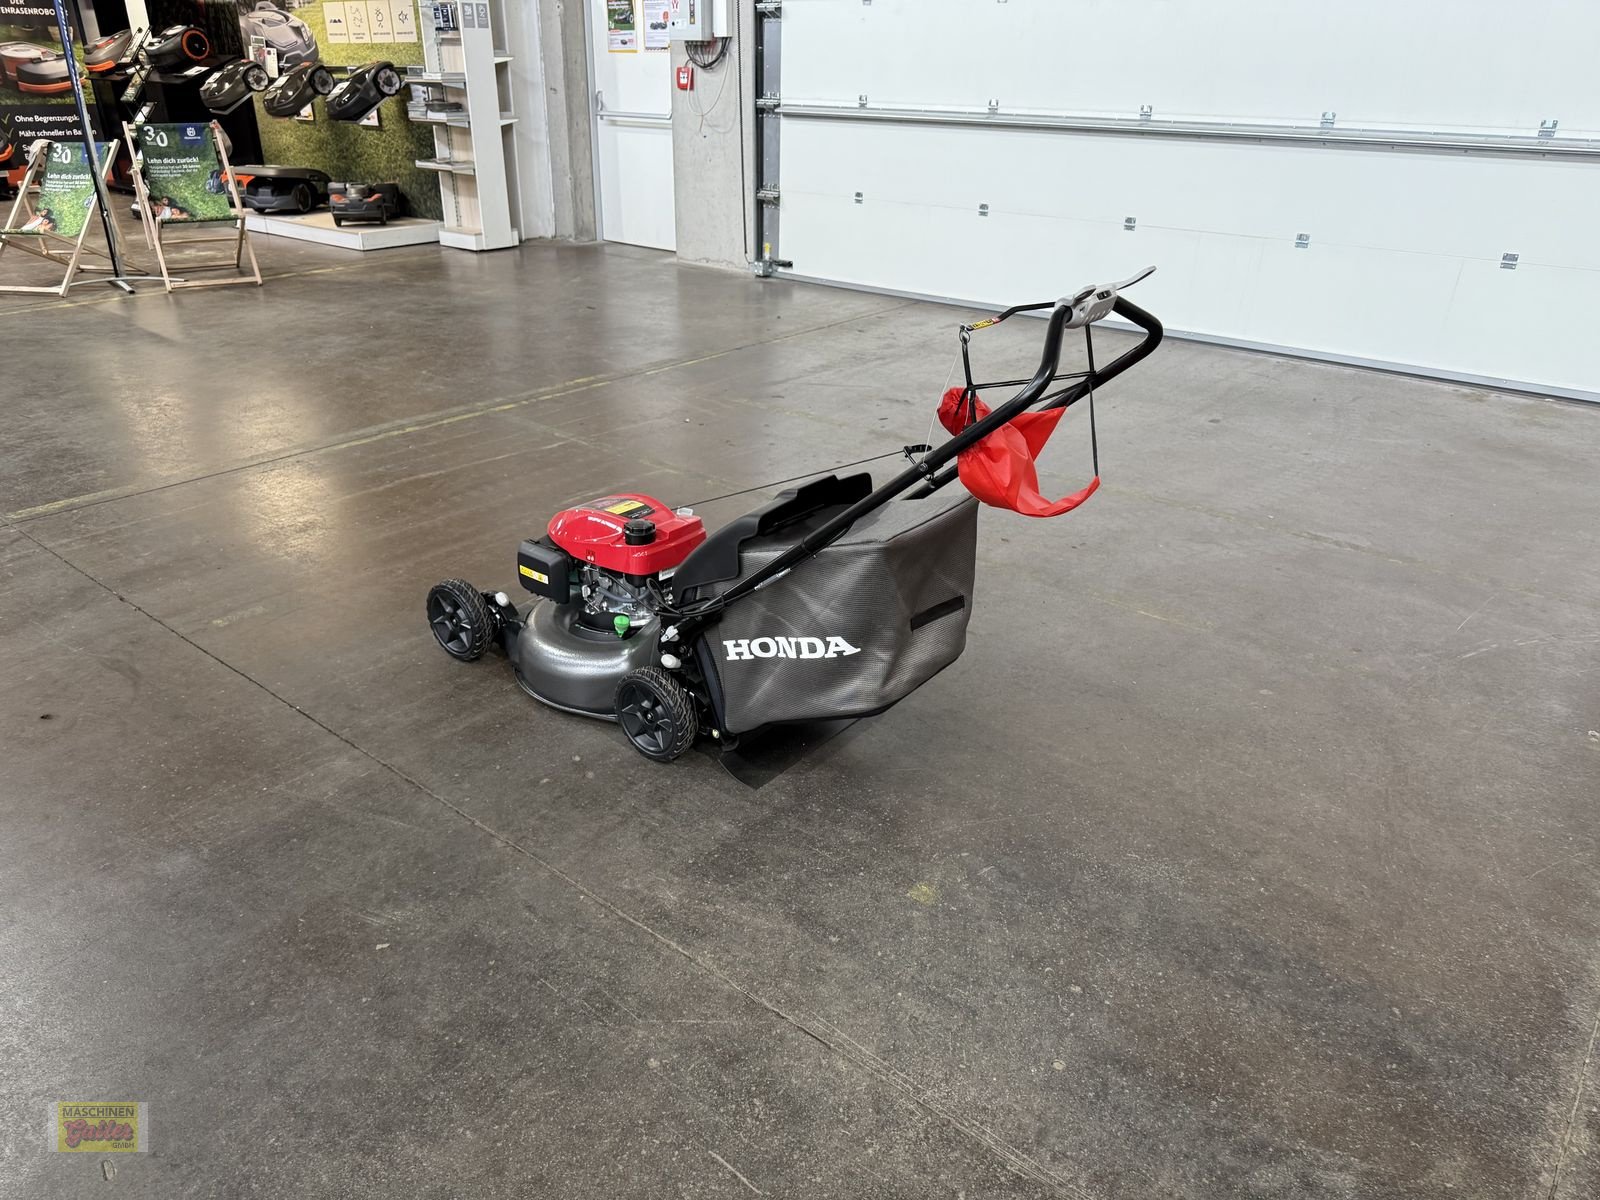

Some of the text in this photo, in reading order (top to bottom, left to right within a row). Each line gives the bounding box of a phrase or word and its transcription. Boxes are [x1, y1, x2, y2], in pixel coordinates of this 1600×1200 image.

[0, 6, 68, 16] ENRASENROBO
[15, 114, 91, 124] Ohne Begrenzungskl
[37, 128, 64, 136] schneller
[723, 636, 861, 661] HONDA
